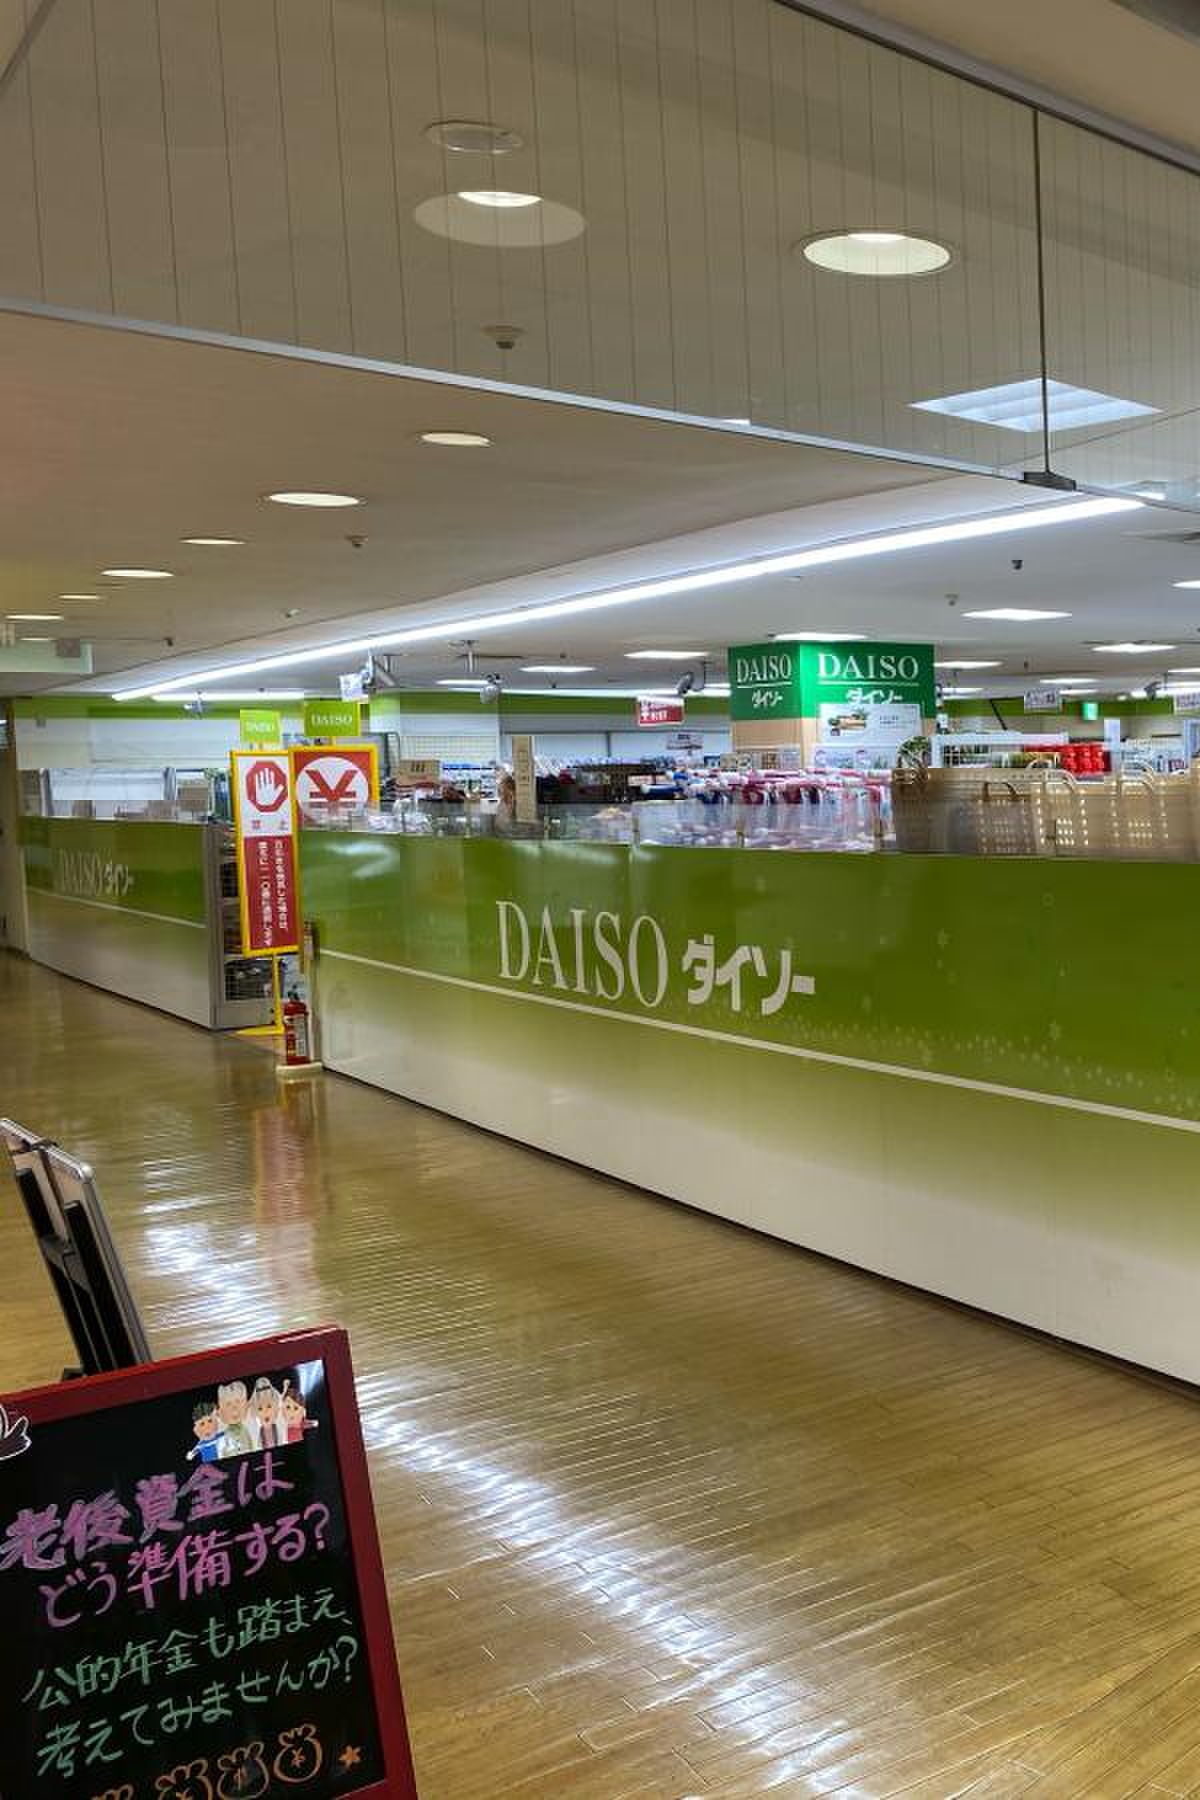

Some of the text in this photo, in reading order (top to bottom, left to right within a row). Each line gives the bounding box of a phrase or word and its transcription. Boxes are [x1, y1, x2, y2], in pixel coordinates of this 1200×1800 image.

[737, 654, 793, 683] DAISO
[818, 653, 920, 680] DAISO
[752, 689, 783, 708] ダイソー
[845, 687, 904, 704] ダイソー
[311, 713, 353, 727] DAISO
[496, 900, 816, 1016] DAISO ダイソー
[0, 1451, 295, 1570] 老後資金は
[22, 1587, 354, 1711] 公的年金も踏まえ、
